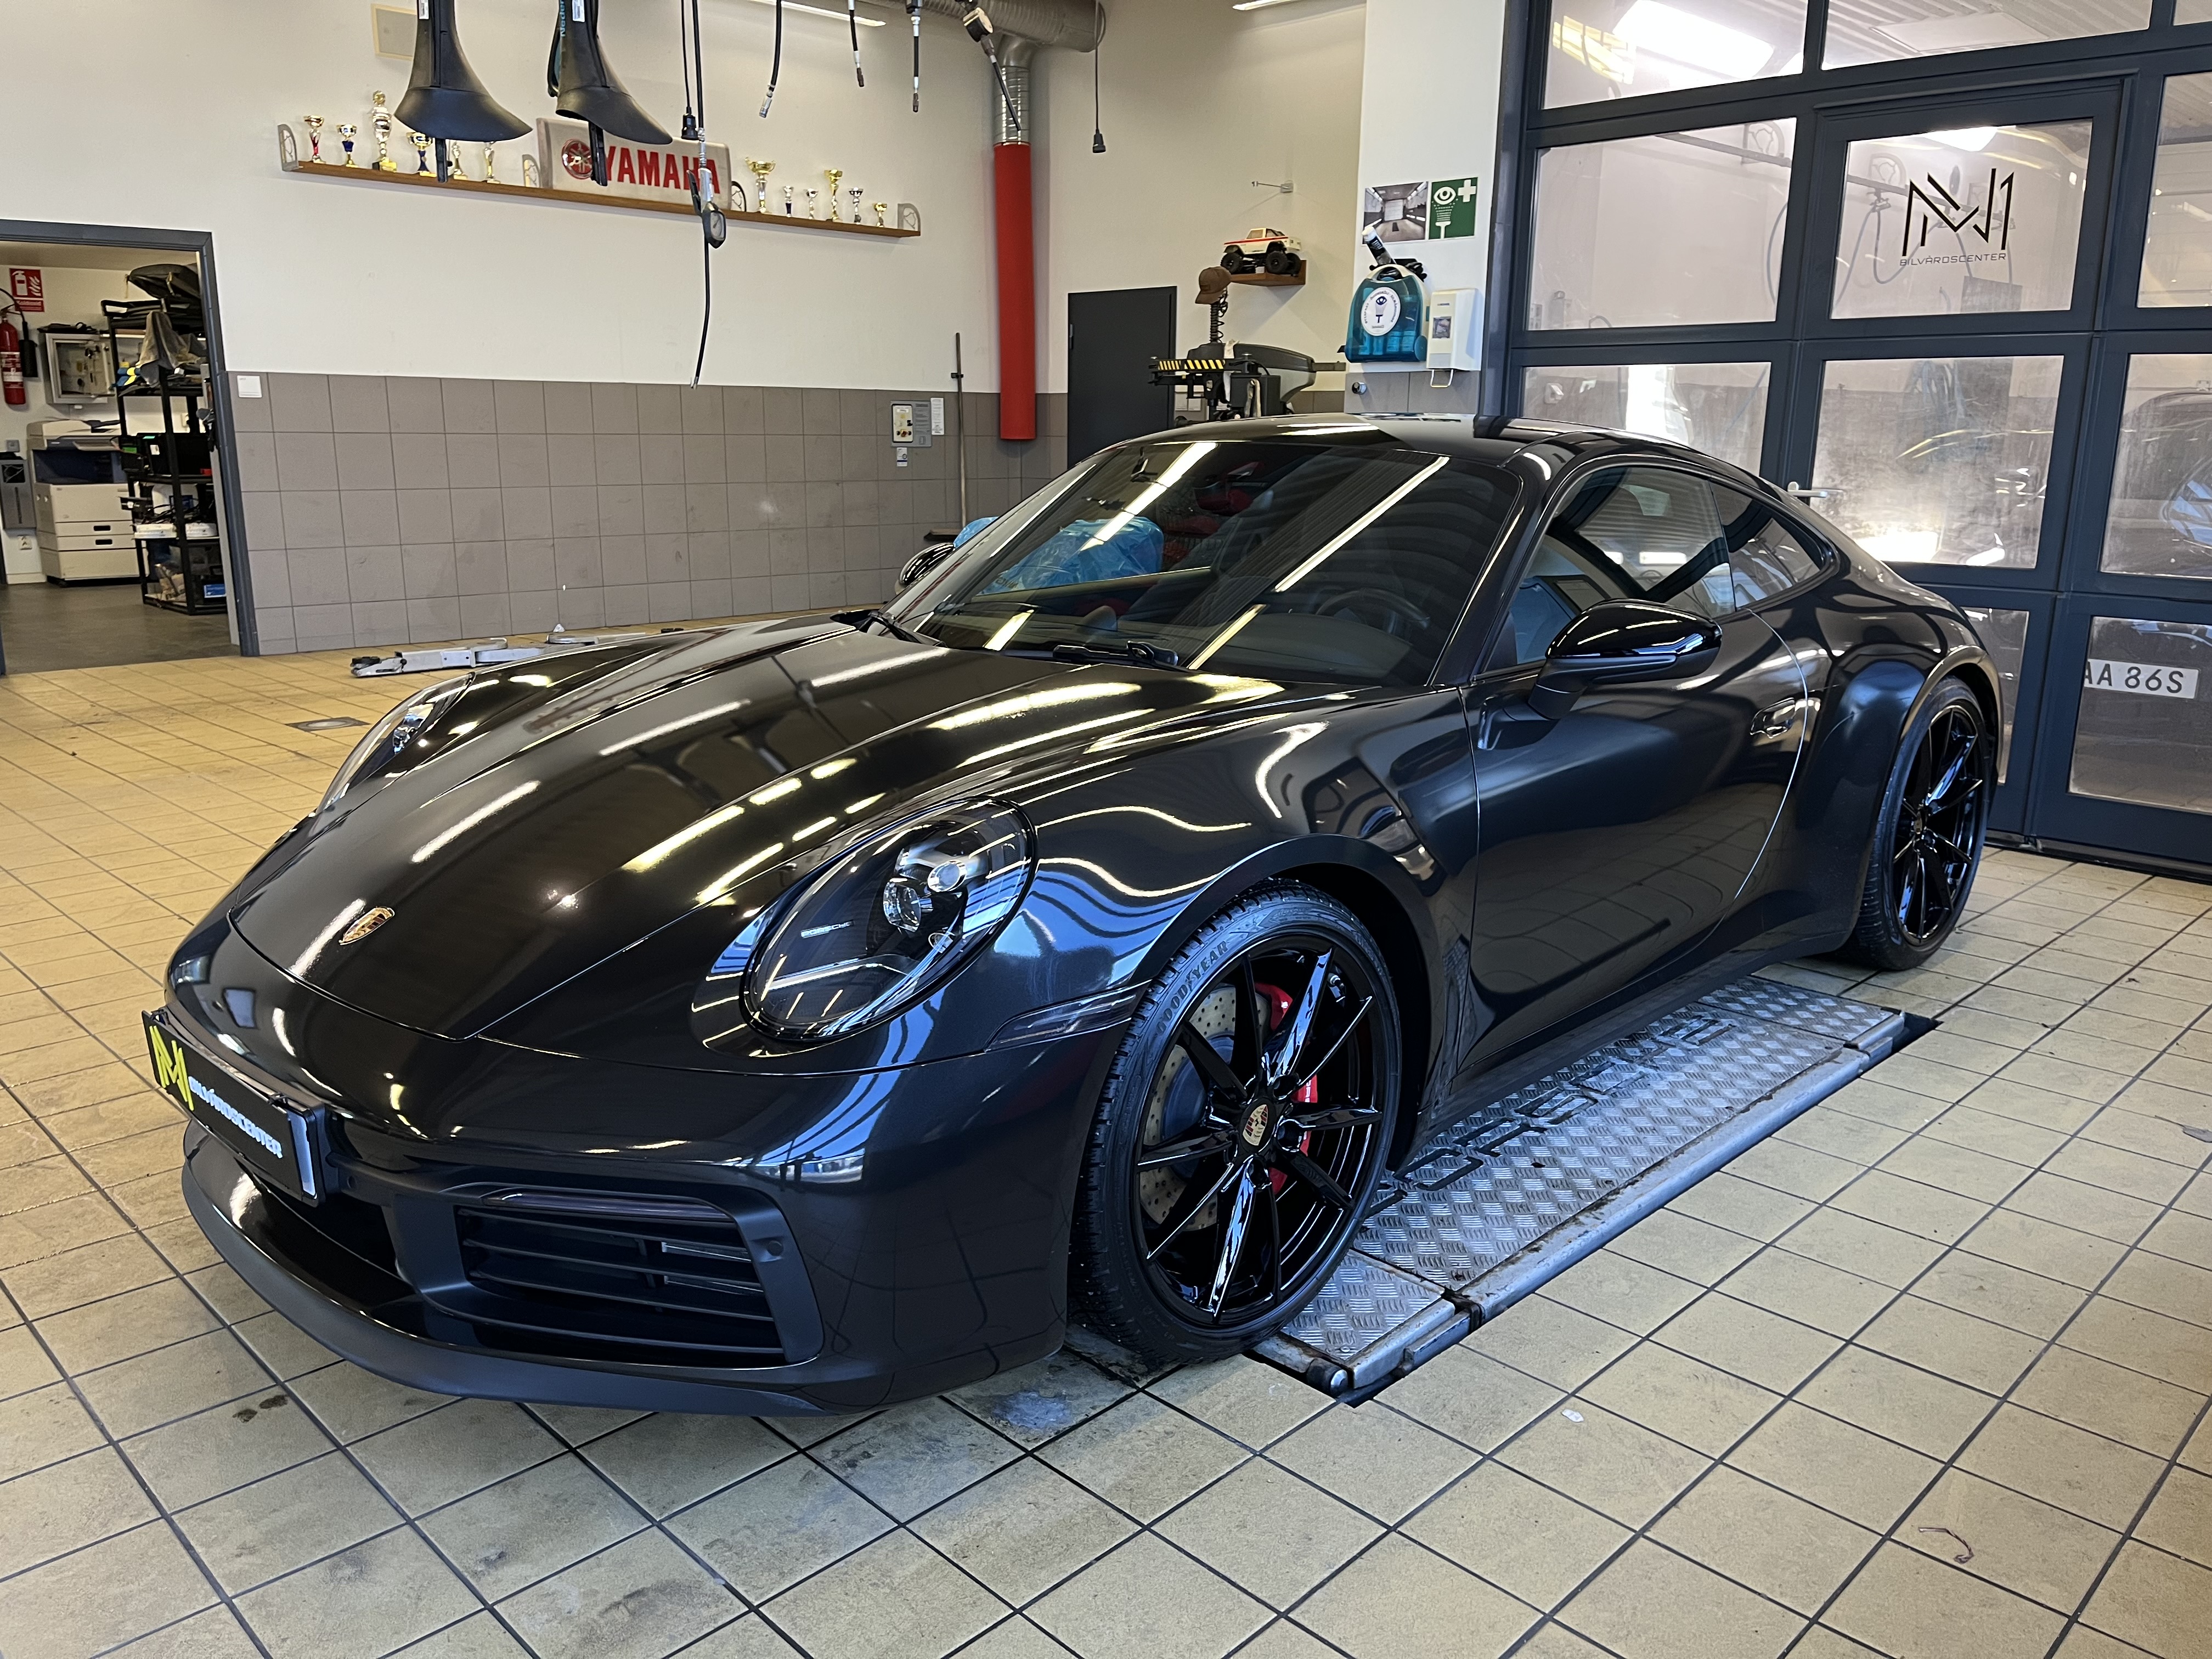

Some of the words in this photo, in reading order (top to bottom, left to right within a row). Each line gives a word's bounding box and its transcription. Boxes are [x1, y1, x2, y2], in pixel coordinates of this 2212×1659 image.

[606, 145, 720, 194] YAMAHA
[1899, 253, 2006, 266] BILVÅRDSCENTER
[2124, 666, 2183, 693] 86S
[1156, 940, 1228, 1036] GOODYEAR
